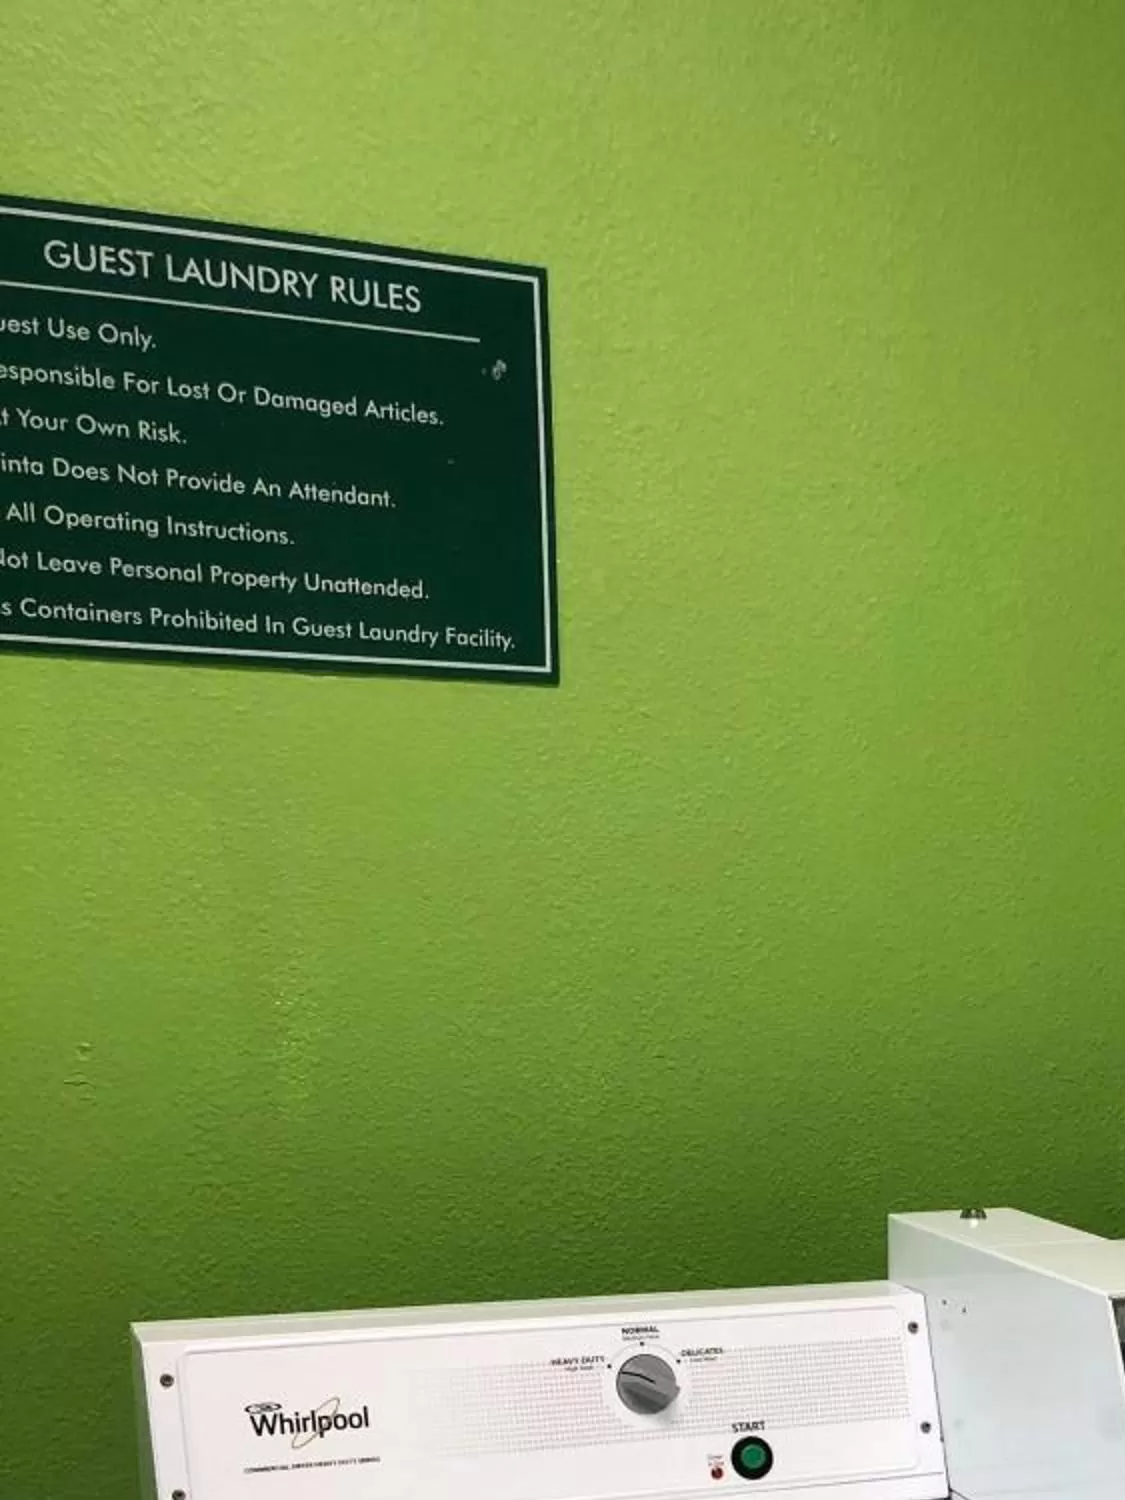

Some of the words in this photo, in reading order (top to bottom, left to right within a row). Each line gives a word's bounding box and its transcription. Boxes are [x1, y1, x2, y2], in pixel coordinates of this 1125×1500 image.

[43, 239, 155, 279] GUEST
[165, 253, 319, 299] LAUNDRY
[329, 275, 421, 313] RULES
[47, 317, 90, 341] Use
[97, 322, 156, 353] Only.
[123, 371, 160, 394] For
[167, 376, 210, 400] Lost
[217, 382, 247, 403] Or
[253, 386, 357, 418] Damaged
[364, 399, 444, 425] Articles.
[15, 407, 69, 431] Your
[76, 413, 130, 438] Own
[138, 419, 187, 444] Risk.
[52, 457, 110, 482] Does
[117, 463, 159, 486] Not
[166, 467, 246, 495] Provide
[252, 477, 282, 497] An
[288, 481, 396, 508] Attendant.
[6, 501, 36, 523] All
[43, 504, 159, 538] Operating
[167, 515, 295, 545] Instructions.
[37, 551, 102, 575] Leave
[109, 556, 203, 583] Personal
[210, 565, 298, 593] Property
[304, 572, 429, 599] Unattended.
[19, 597, 143, 625] Containers
[150, 607, 258, 633] Prohibited
[265, 615, 285, 634] In
[292, 616, 353, 639] Guest
[359, 621, 439, 649] Laundry
[445, 626, 515, 653] Facility.
[250, 1404, 370, 1439] Whirlpool
[731, 1420, 766, 1434] START
